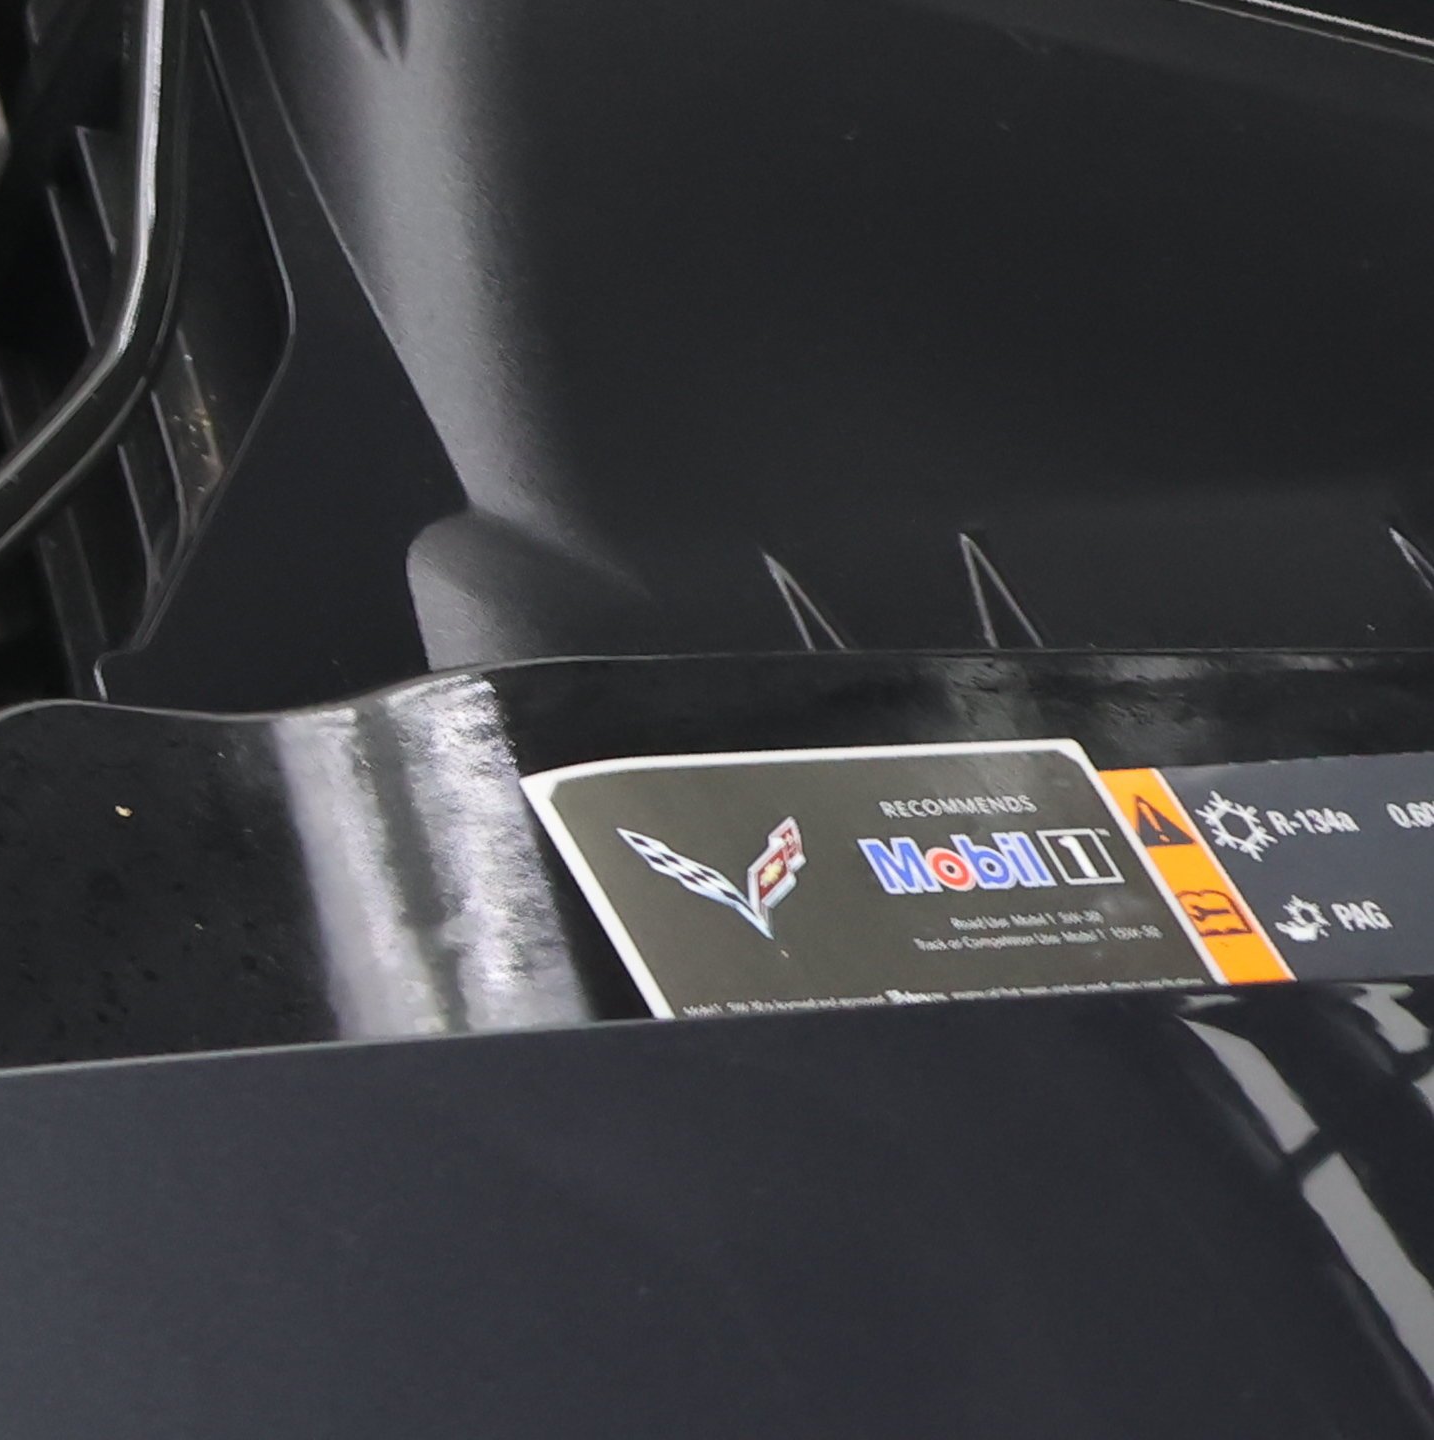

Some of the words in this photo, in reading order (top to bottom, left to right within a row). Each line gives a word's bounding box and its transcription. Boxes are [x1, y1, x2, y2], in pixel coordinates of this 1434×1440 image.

[879, 794, 1038, 819] RECOMMENDS
[1266, 807, 1360, 836] R-134a
[857, 831, 1058, 895] Mobil
[1331, 900, 1393, 932] PAG
